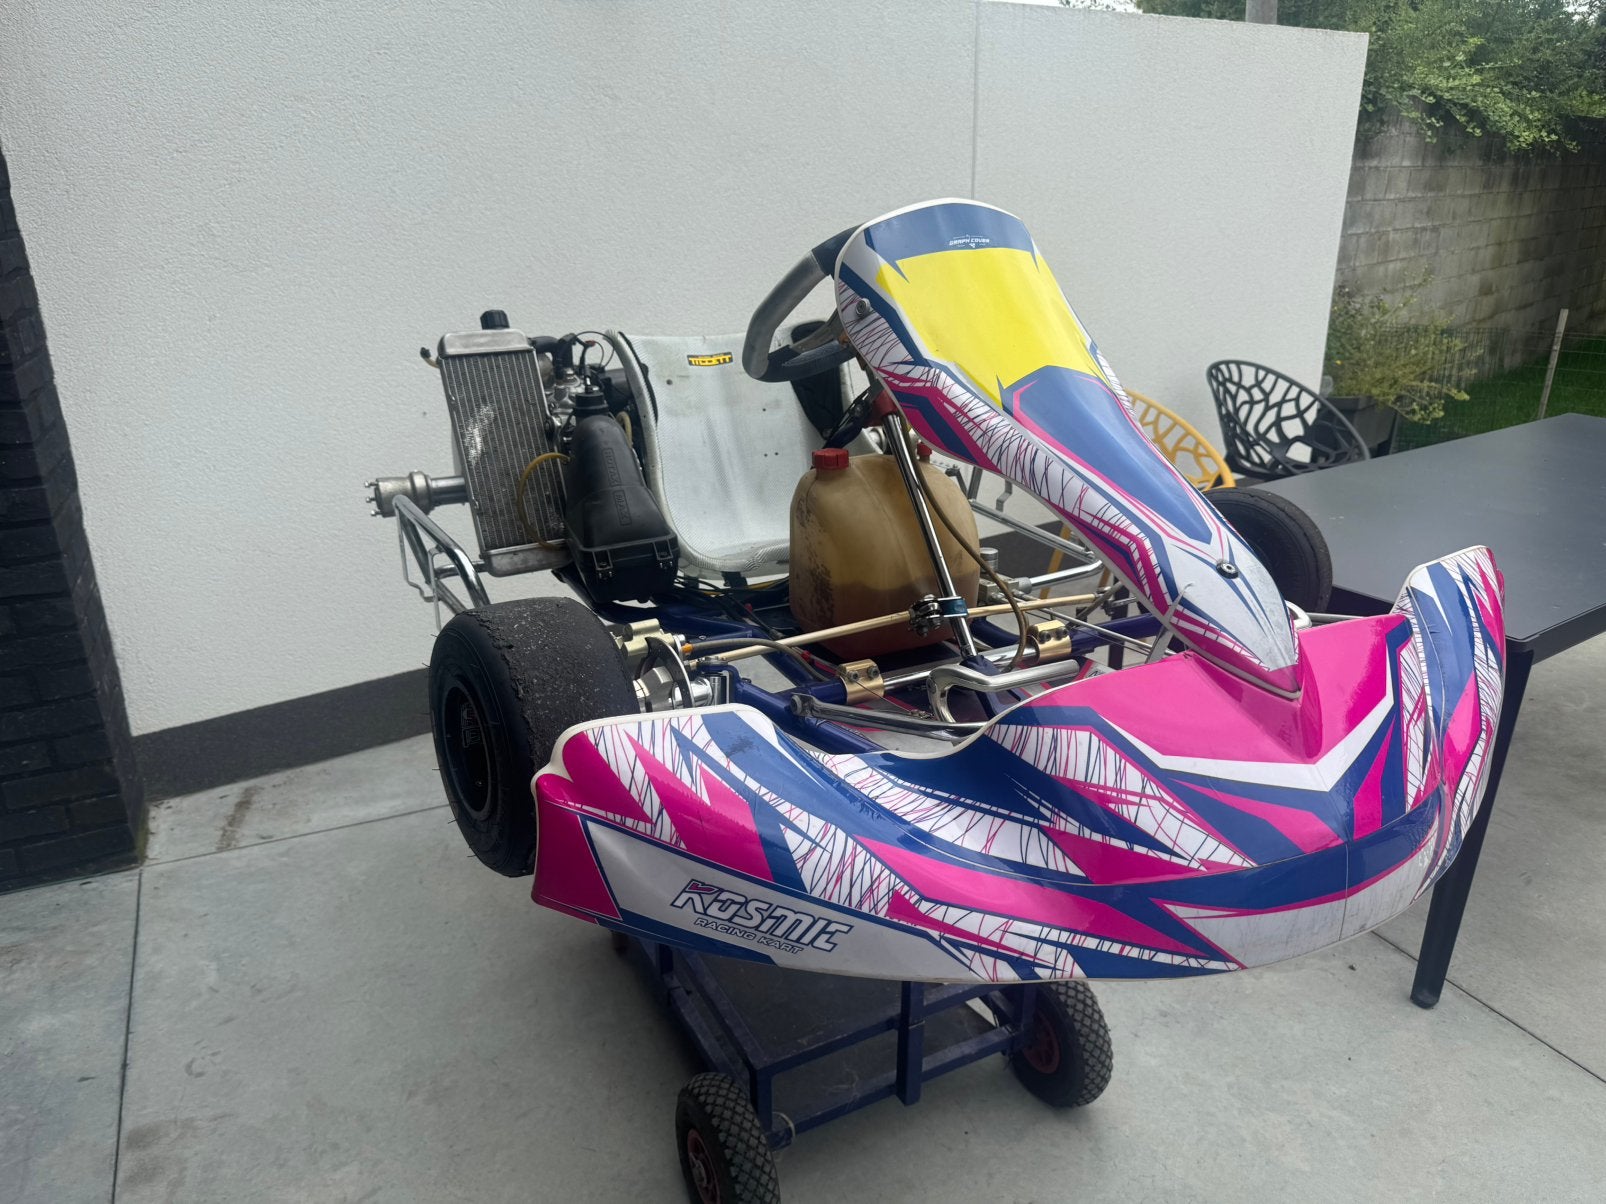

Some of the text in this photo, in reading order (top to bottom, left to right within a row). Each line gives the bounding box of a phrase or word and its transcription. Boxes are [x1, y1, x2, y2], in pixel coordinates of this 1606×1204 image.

[603, 450, 629, 521] ROTAX MAX
[670, 878, 854, 952] KOSMIC
[694, 917, 803, 955] RACING KART
